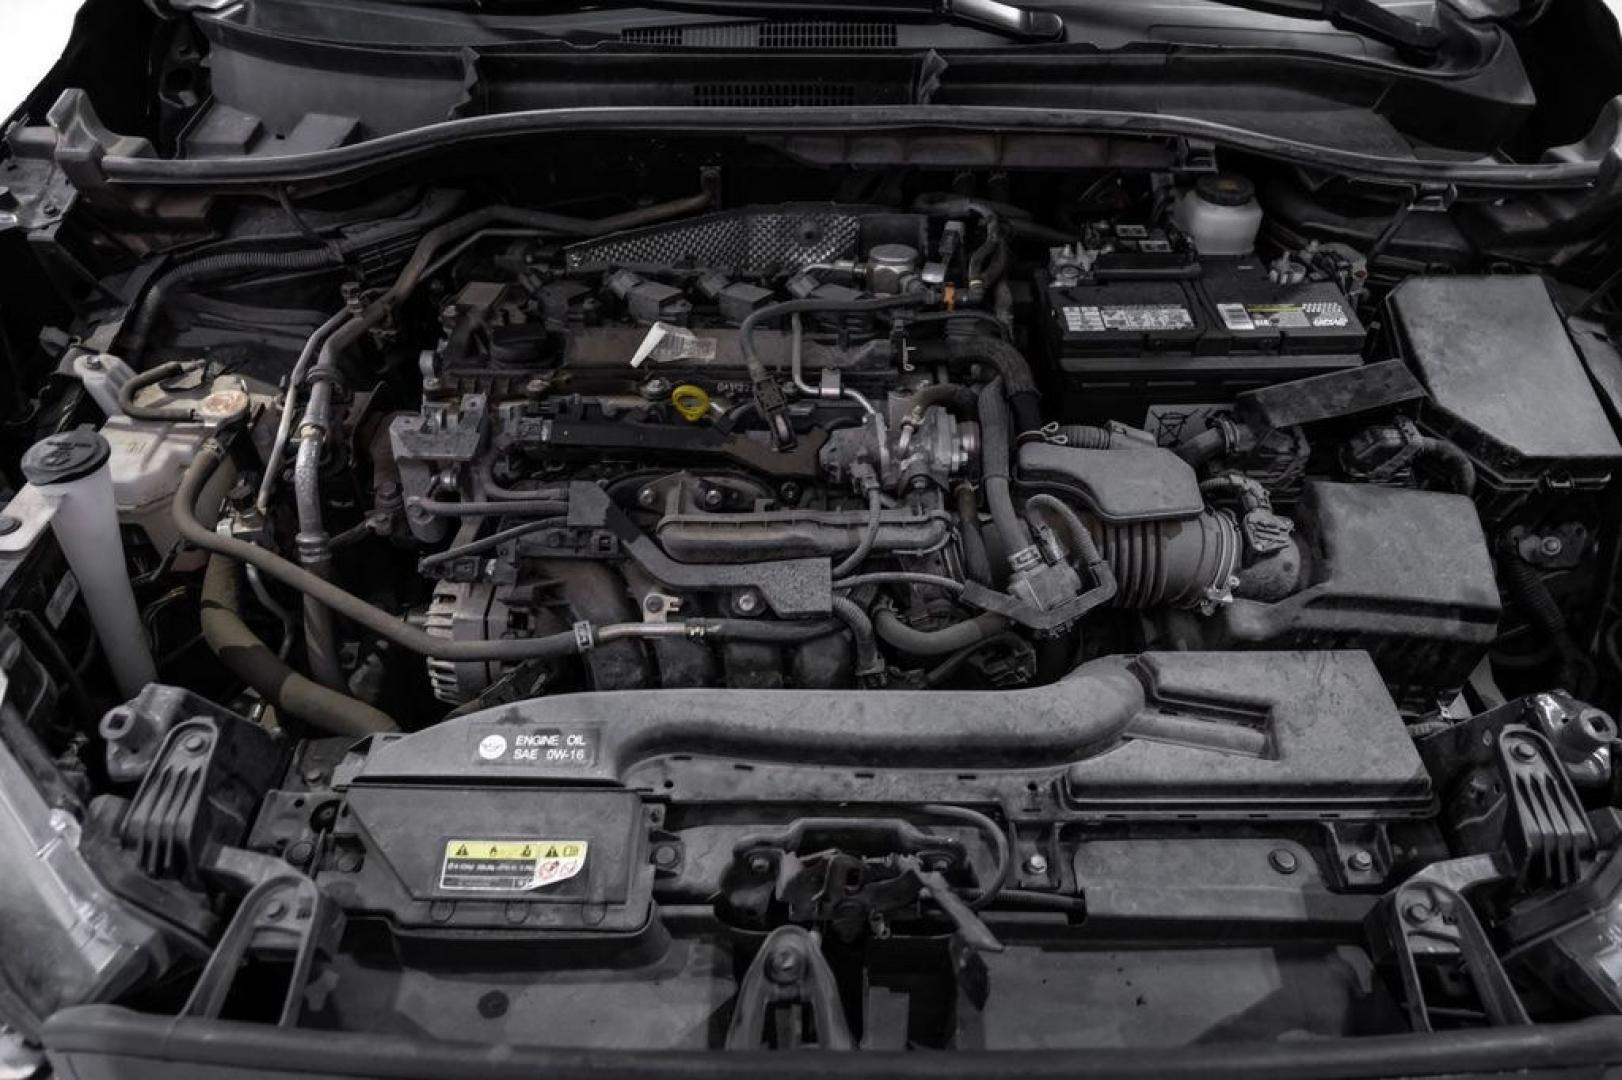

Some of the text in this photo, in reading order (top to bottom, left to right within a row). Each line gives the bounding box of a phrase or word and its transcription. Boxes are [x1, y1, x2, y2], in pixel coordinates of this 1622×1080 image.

[515, 734, 586, 746] ENGINE OIL
[513, 748, 584, 760] SAE 0W-16
